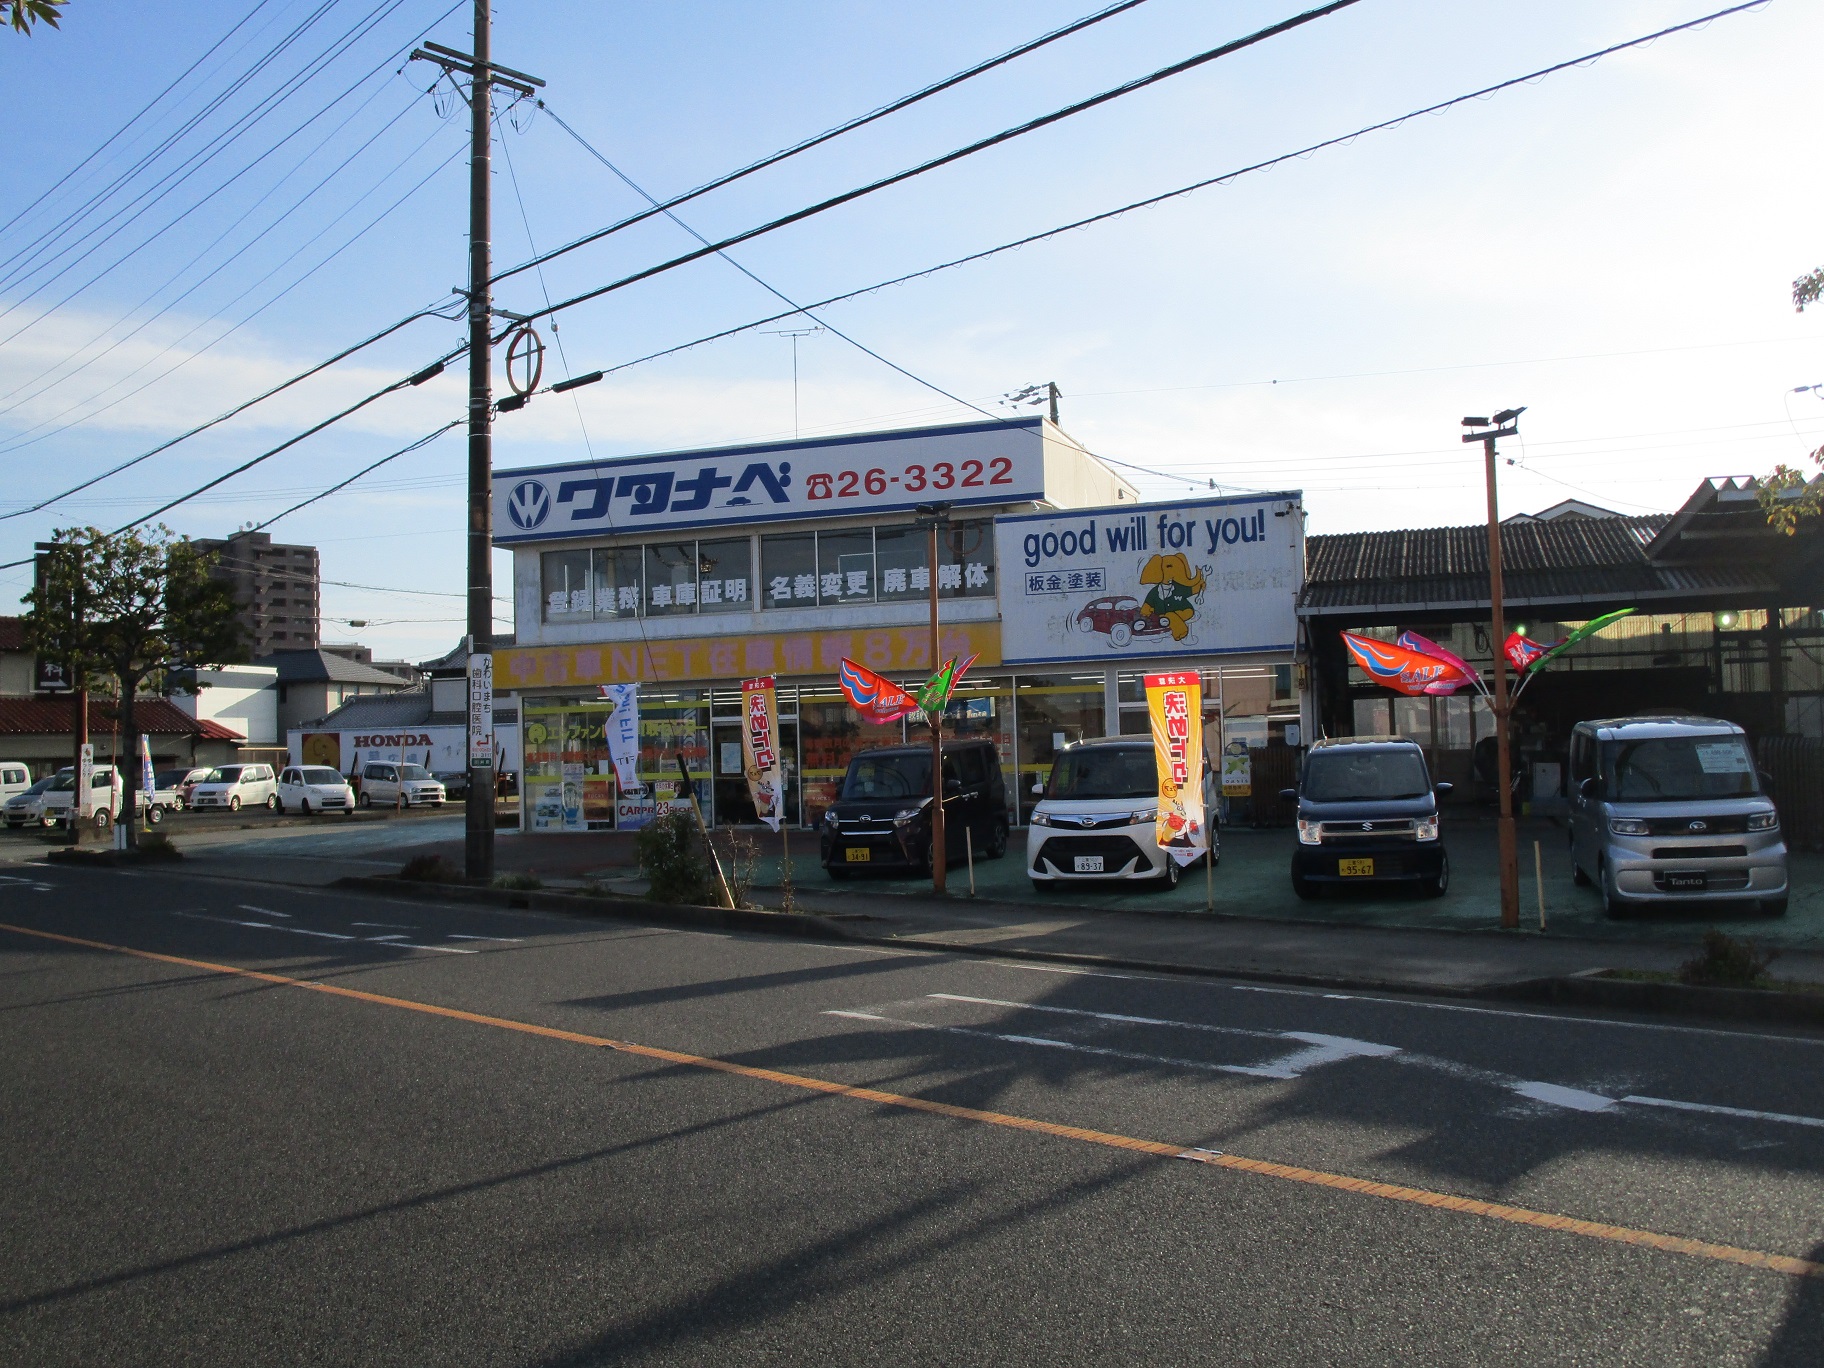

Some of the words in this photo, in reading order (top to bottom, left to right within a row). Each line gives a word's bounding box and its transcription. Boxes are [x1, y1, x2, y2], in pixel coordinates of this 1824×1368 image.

[556, 461, 792, 521] ワタナベ
[837, 457, 1013, 497] 26-3322
[1023, 520, 1096, 568] good
[1106, 515, 1148, 553] will
[1157, 513, 1196, 549] for
[1205, 508, 1266, 555] you!
[549, 586, 640, 613] 登録業務
[652, 578, 747, 608] 車庫証明
[770, 570, 868, 600] 名義変更
[884, 562, 988, 593] 廃車解体
[472, 668, 482, 736] 歯科口腔医院
[483, 657, 492, 713] かわいまち
[354, 734, 433, 748] HONDA
[619, 805, 655, 816] CARPR
[656, 801, 669, 816] 23
[1669, 877, 1703, 886] Tanto
